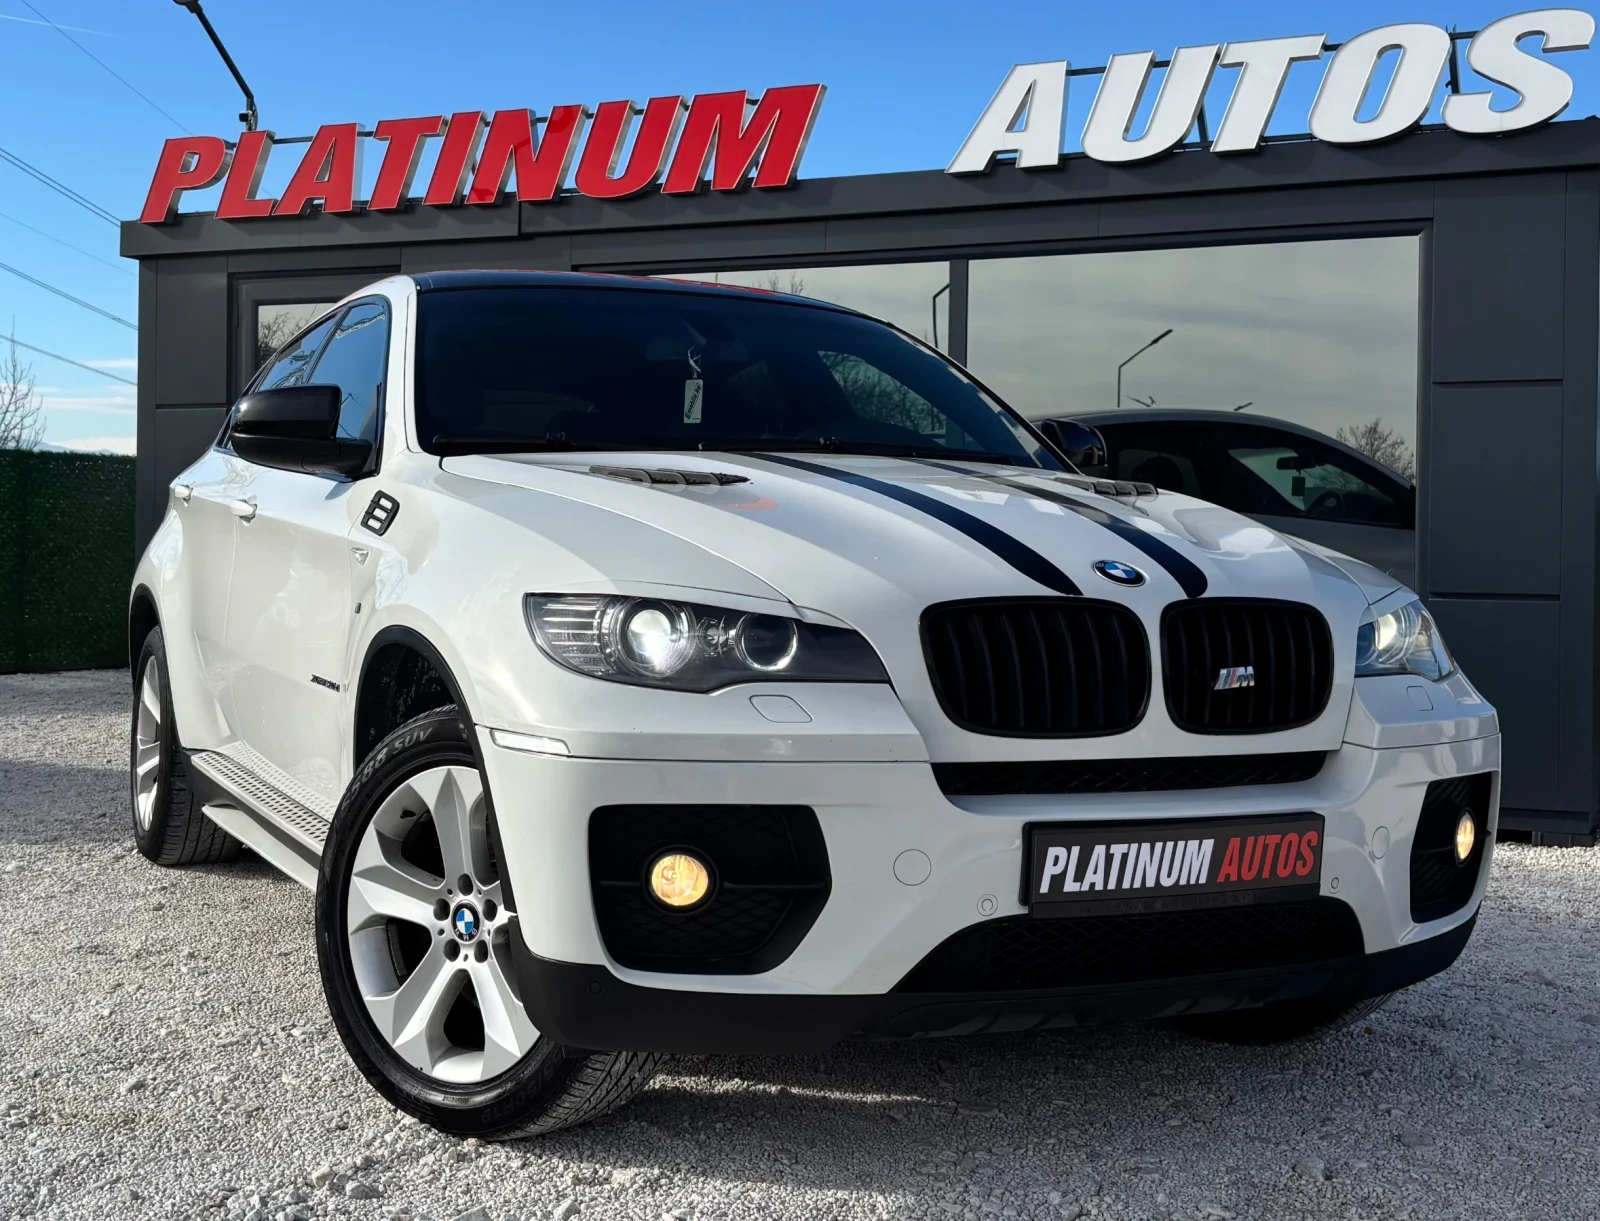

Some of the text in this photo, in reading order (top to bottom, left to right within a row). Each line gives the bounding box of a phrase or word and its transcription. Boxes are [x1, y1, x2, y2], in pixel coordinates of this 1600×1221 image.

[139, 8, 1597, 224] PLATINUM AUTOS
[393, 727, 433, 755] SUV
[1039, 831, 1318, 894] PLATINUM AUTOS
